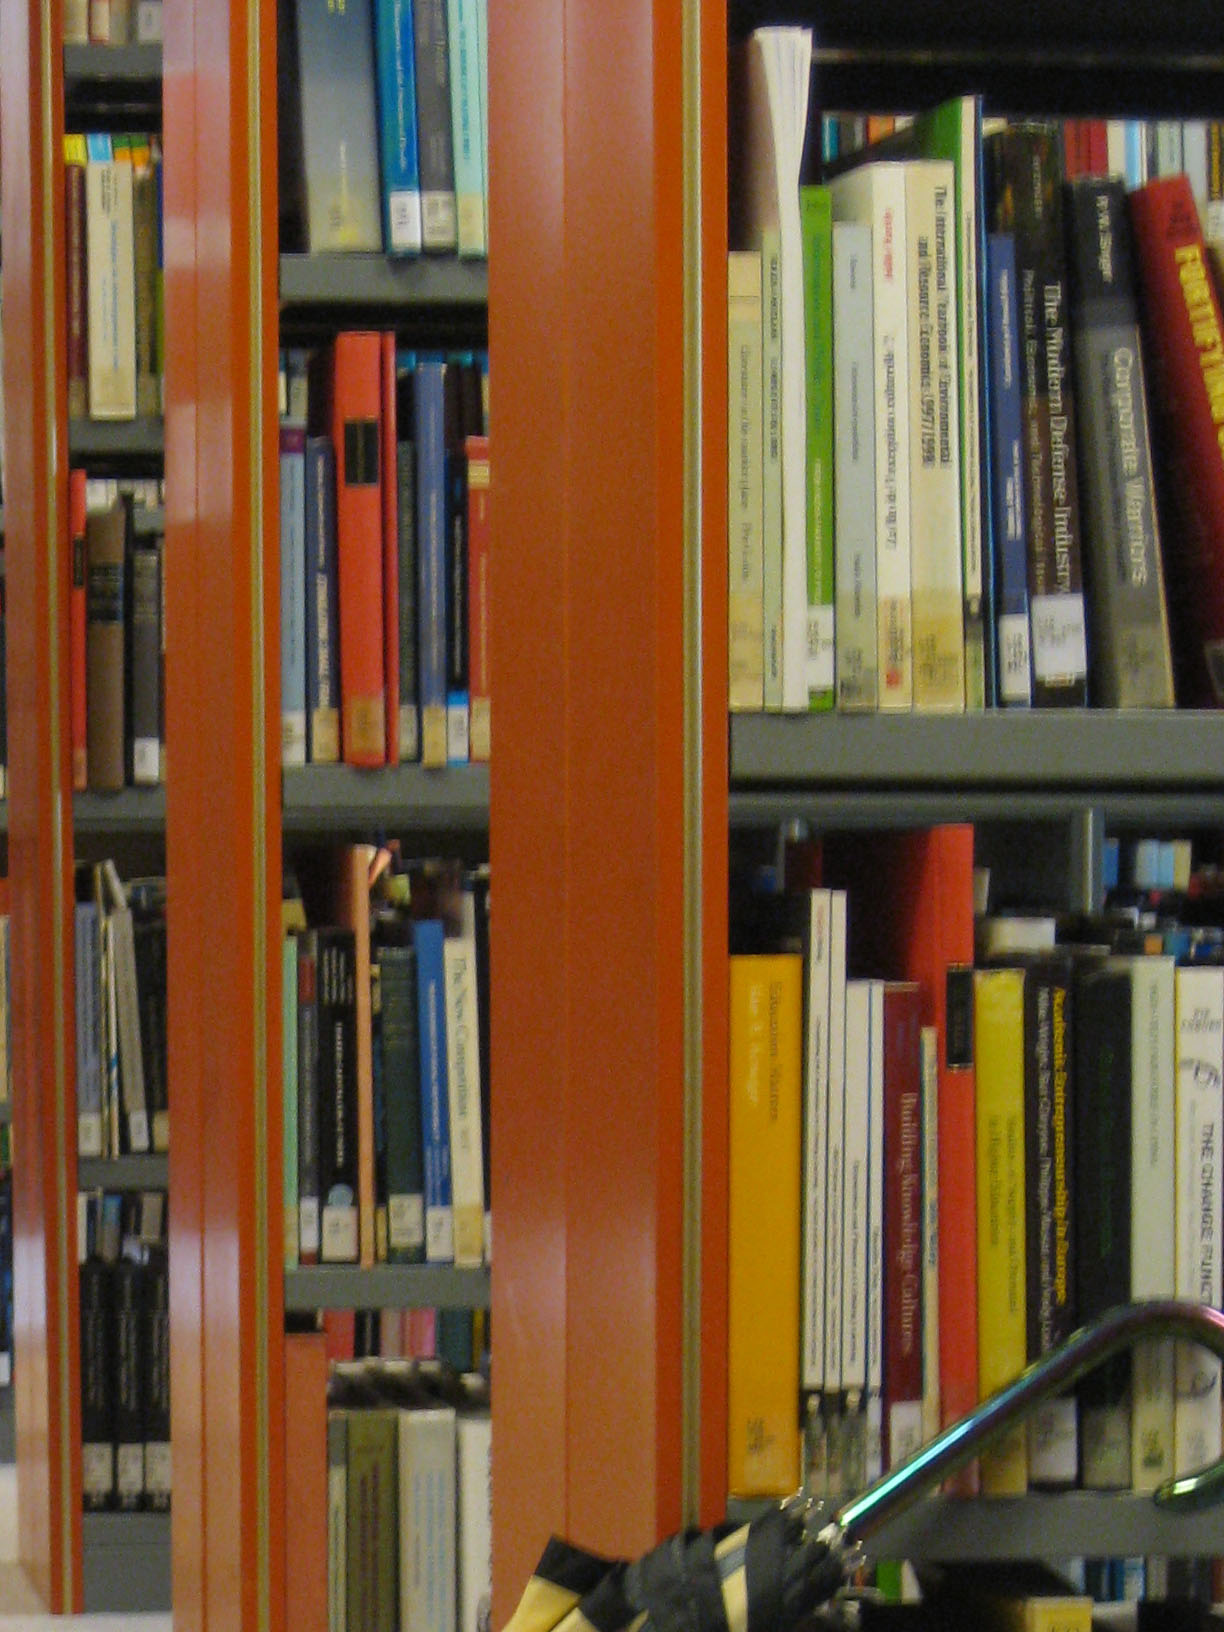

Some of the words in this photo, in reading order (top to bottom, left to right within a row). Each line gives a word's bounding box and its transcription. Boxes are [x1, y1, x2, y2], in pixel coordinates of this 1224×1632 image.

[935, 186, 948, 207] The
[918, 236, 932, 257] and
[935, 212, 949, 291] International
[918, 260, 933, 320] Resource
[937, 295, 951, 352] Yearbook
[1043, 281, 1063, 327] The
[919, 324, 934, 390] Economics
[1045, 327, 1066, 413] Modern
[939, 374, 953, 465] Environmental
[1112, 347, 1139, 476] Corporate
[1049, 416, 1070, 505] Defense
[1054, 506, 1074, 593] Industry
[1124, 477, 1148, 588] Warriors
[453, 956, 467, 985] The
[1054, 987, 1068, 1069] Academic
[895, 1092, 919, 1173] Building
[1052, 1071, 1069, 1219] Entrepreneurship
[1200, 1123, 1215, 1160] THE
[895, 1174, 919, 1270] Knowledge
[1200, 1163, 1214, 1241] CHANGE
[1052, 1240, 1069, 1306] Europe
[901, 1274, 919, 1357] Cultures
